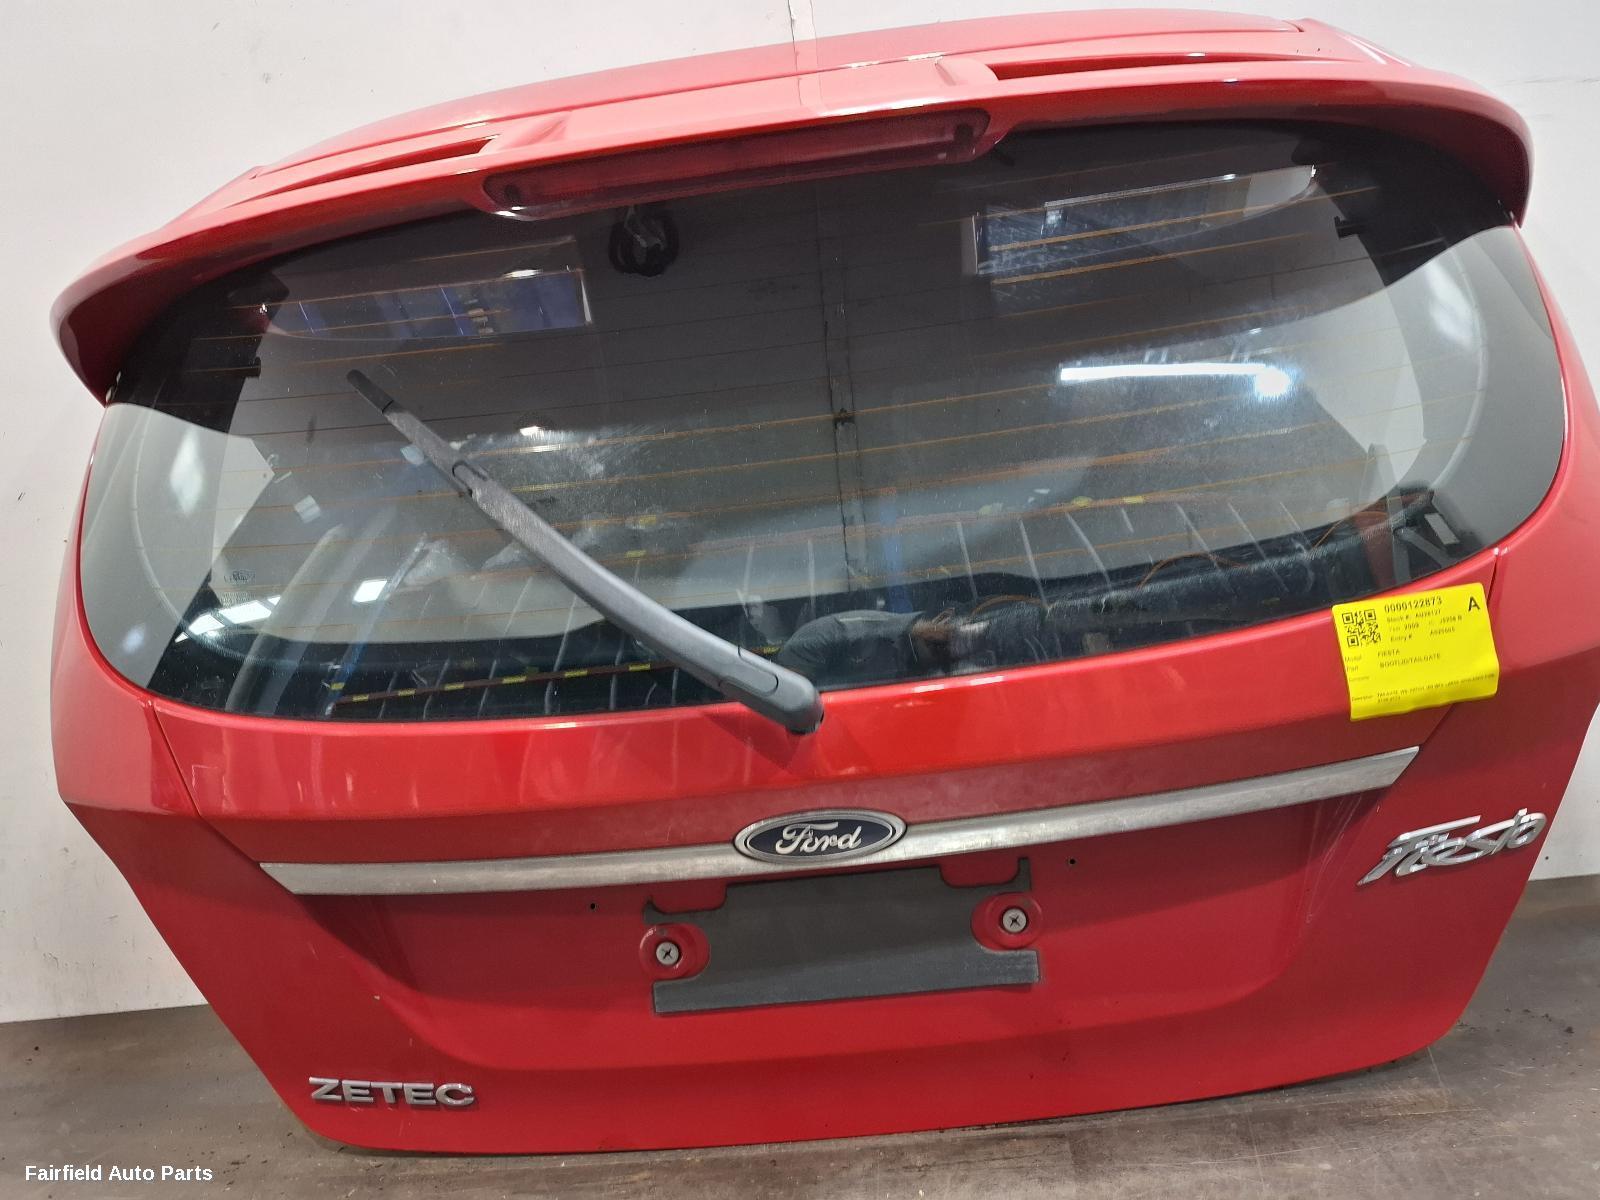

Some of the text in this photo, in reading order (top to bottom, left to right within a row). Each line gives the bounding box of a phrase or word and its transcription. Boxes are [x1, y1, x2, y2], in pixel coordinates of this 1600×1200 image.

[1384, 596, 1442, 613] 0000122873
[1468, 596, 1480, 611] A
[1377, 649, 1400, 658] FIESTA
[776, 821, 861, 855] Ford
[1356, 807, 1547, 887] Fiesta
[309, 1076, 474, 1107] ZETEC
